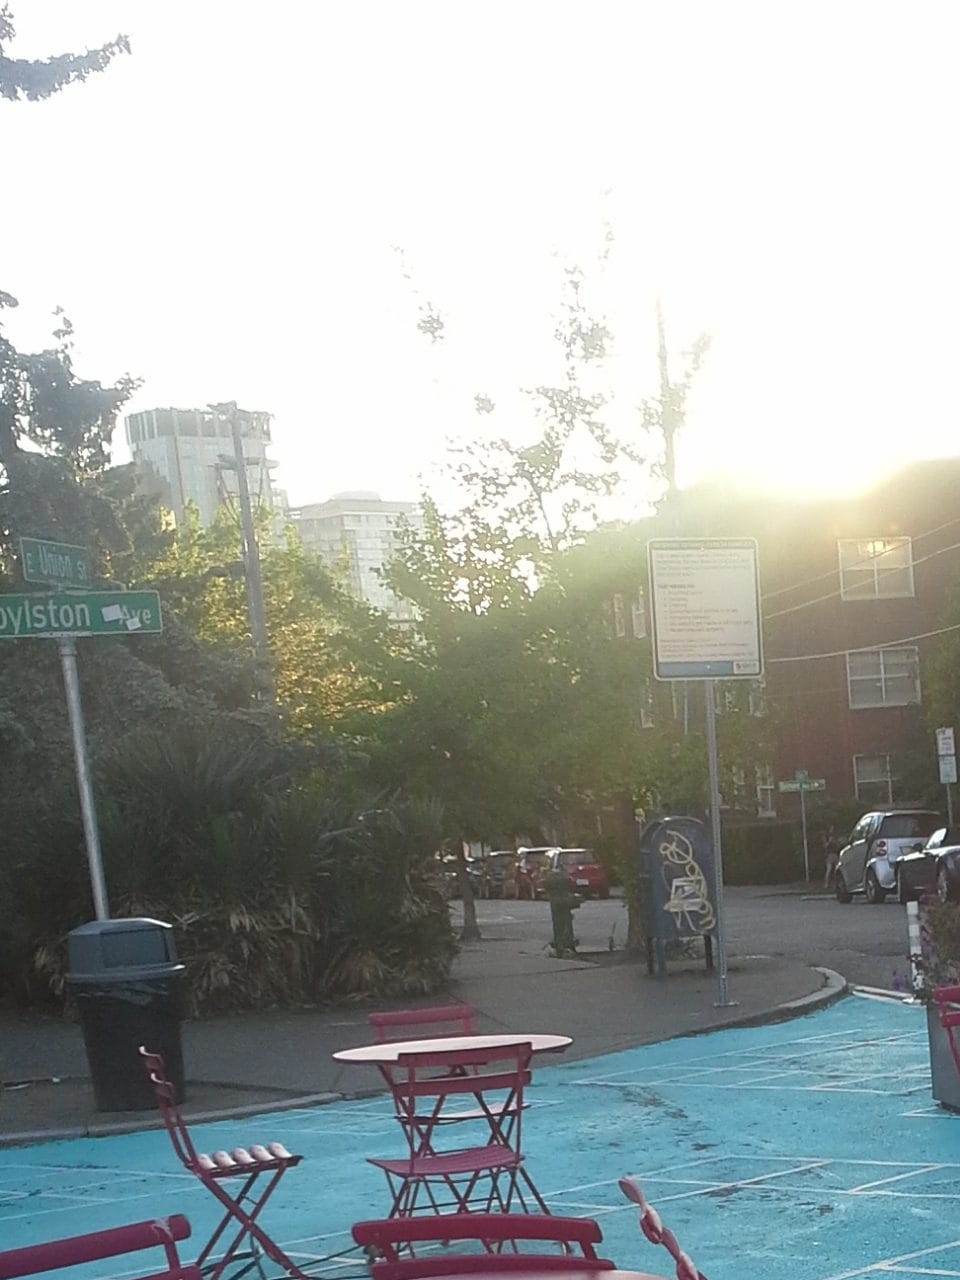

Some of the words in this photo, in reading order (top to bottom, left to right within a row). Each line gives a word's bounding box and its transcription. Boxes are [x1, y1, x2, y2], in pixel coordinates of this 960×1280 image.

[26, 552, 34, 573] E
[37, 545, 73, 578] Union
[119, 604, 152, 626] Ave
